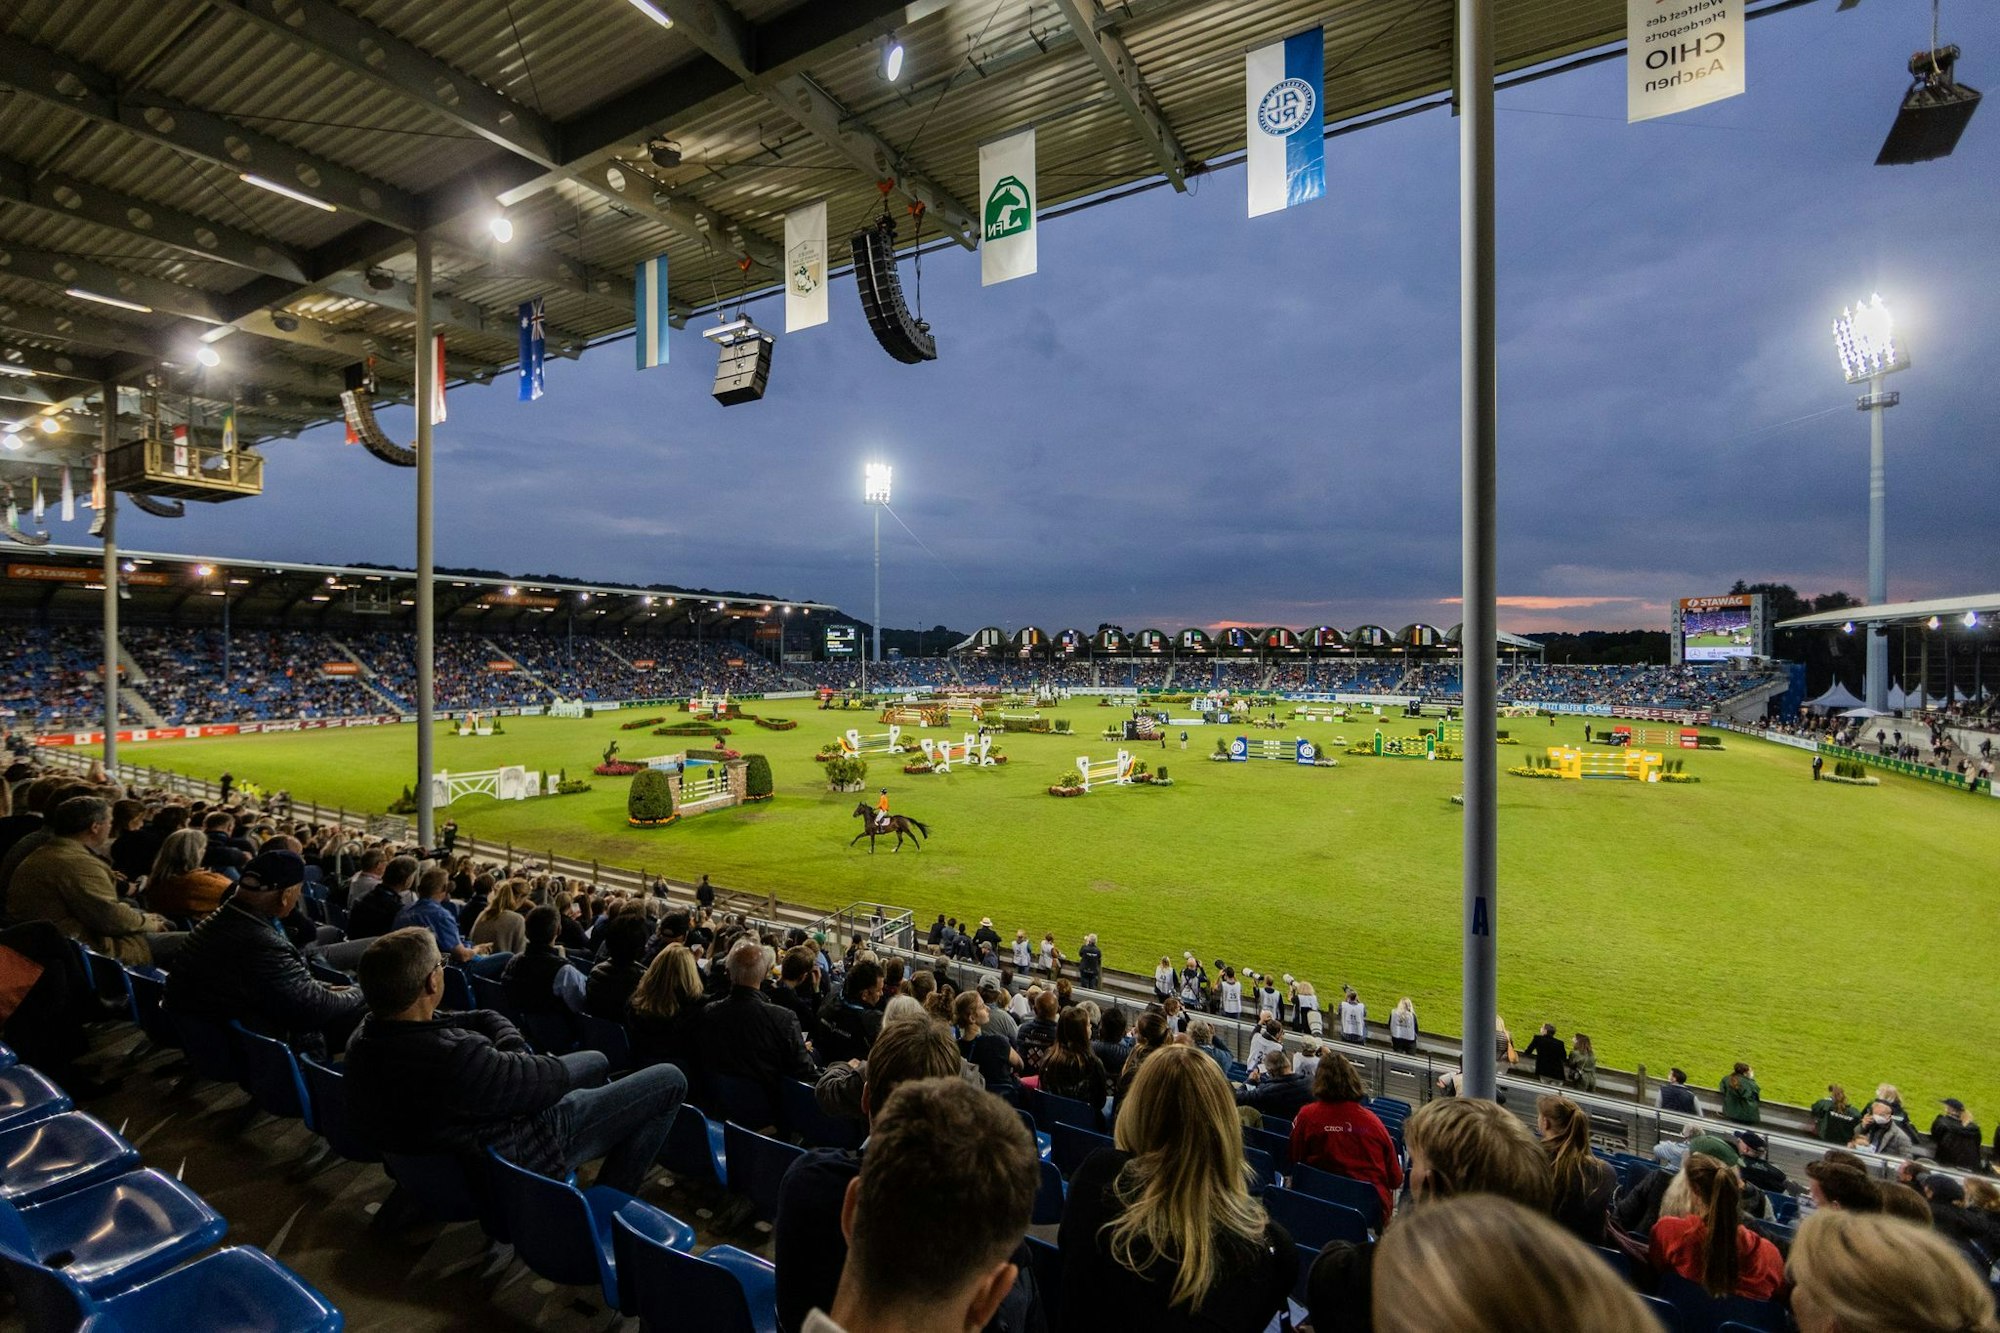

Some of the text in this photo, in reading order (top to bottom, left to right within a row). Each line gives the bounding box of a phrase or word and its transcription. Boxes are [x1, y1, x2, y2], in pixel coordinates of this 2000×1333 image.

[33, 569, 87, 579] STAWAG
[1700, 596, 1743, 607] STAWAG
[1540, 702, 1583, 712] JETZT HELFEN!
[1596, 704, 1611, 712] PLAN
[1472, 896, 1489, 936] A
